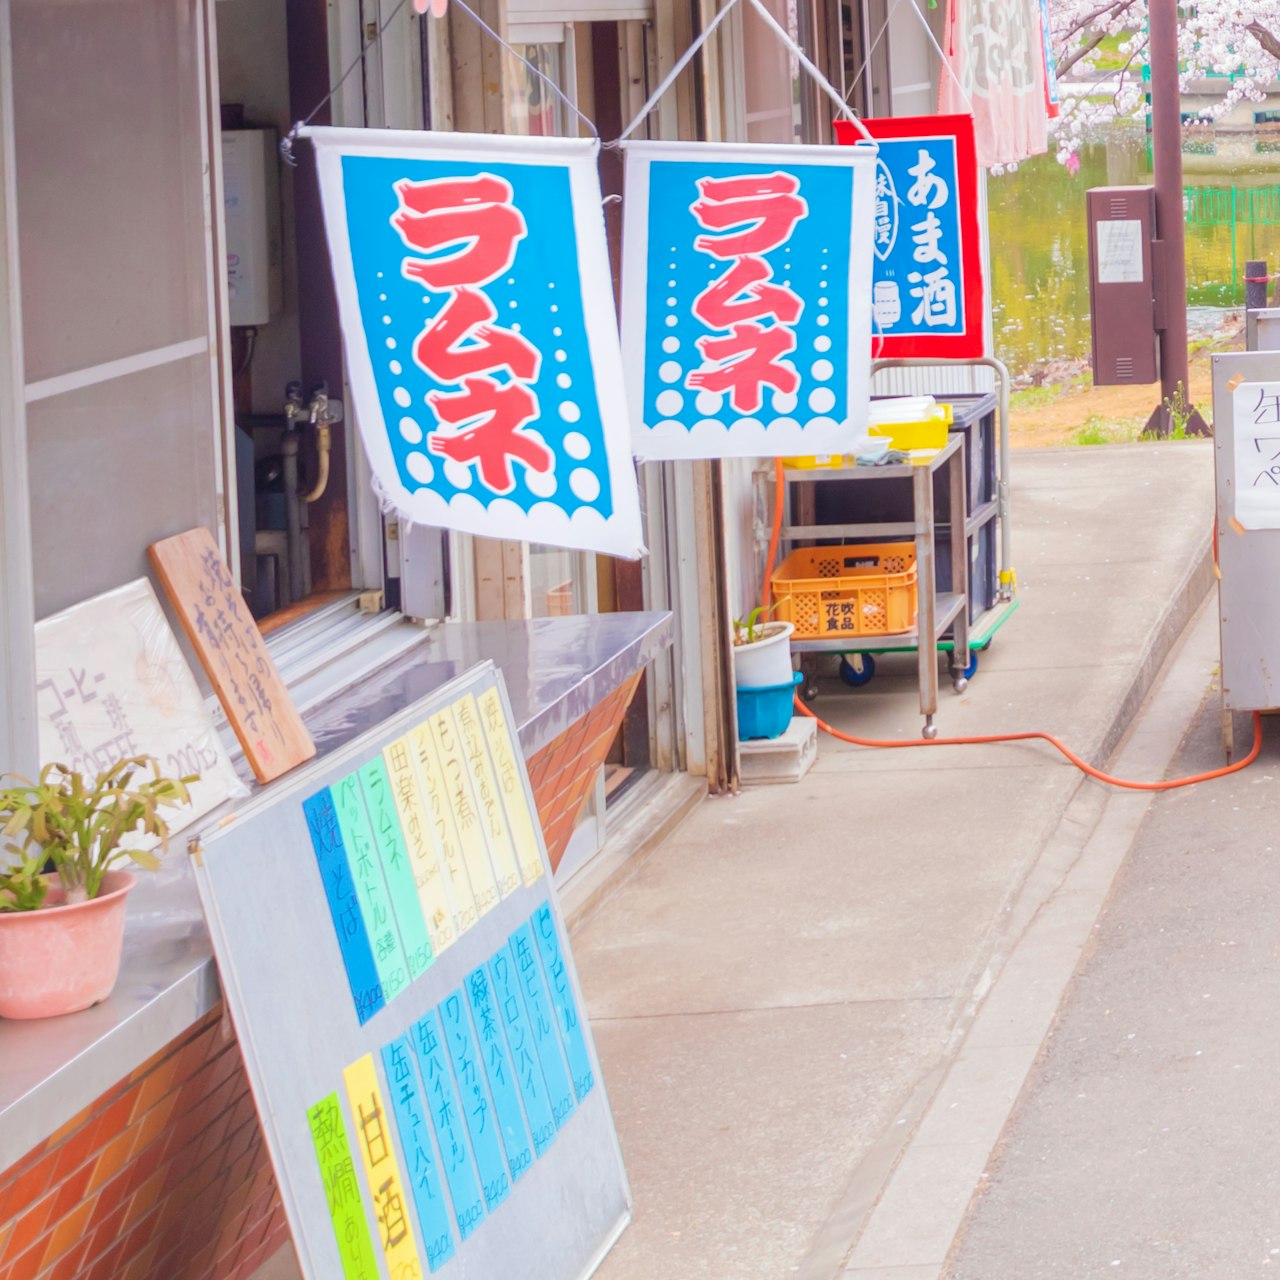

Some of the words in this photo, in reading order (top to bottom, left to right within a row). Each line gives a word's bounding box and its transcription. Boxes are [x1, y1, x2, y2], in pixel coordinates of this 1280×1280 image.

[686, 171, 808, 414] ラムネ
[906, 149, 957, 327] あま酒
[391, 173, 554, 492] ラムネ
[368, 770, 403, 870] ラムネ
[312, 1101, 367, 1280] 熱燗あり
[358, 1091, 408, 1252] 甘酒
